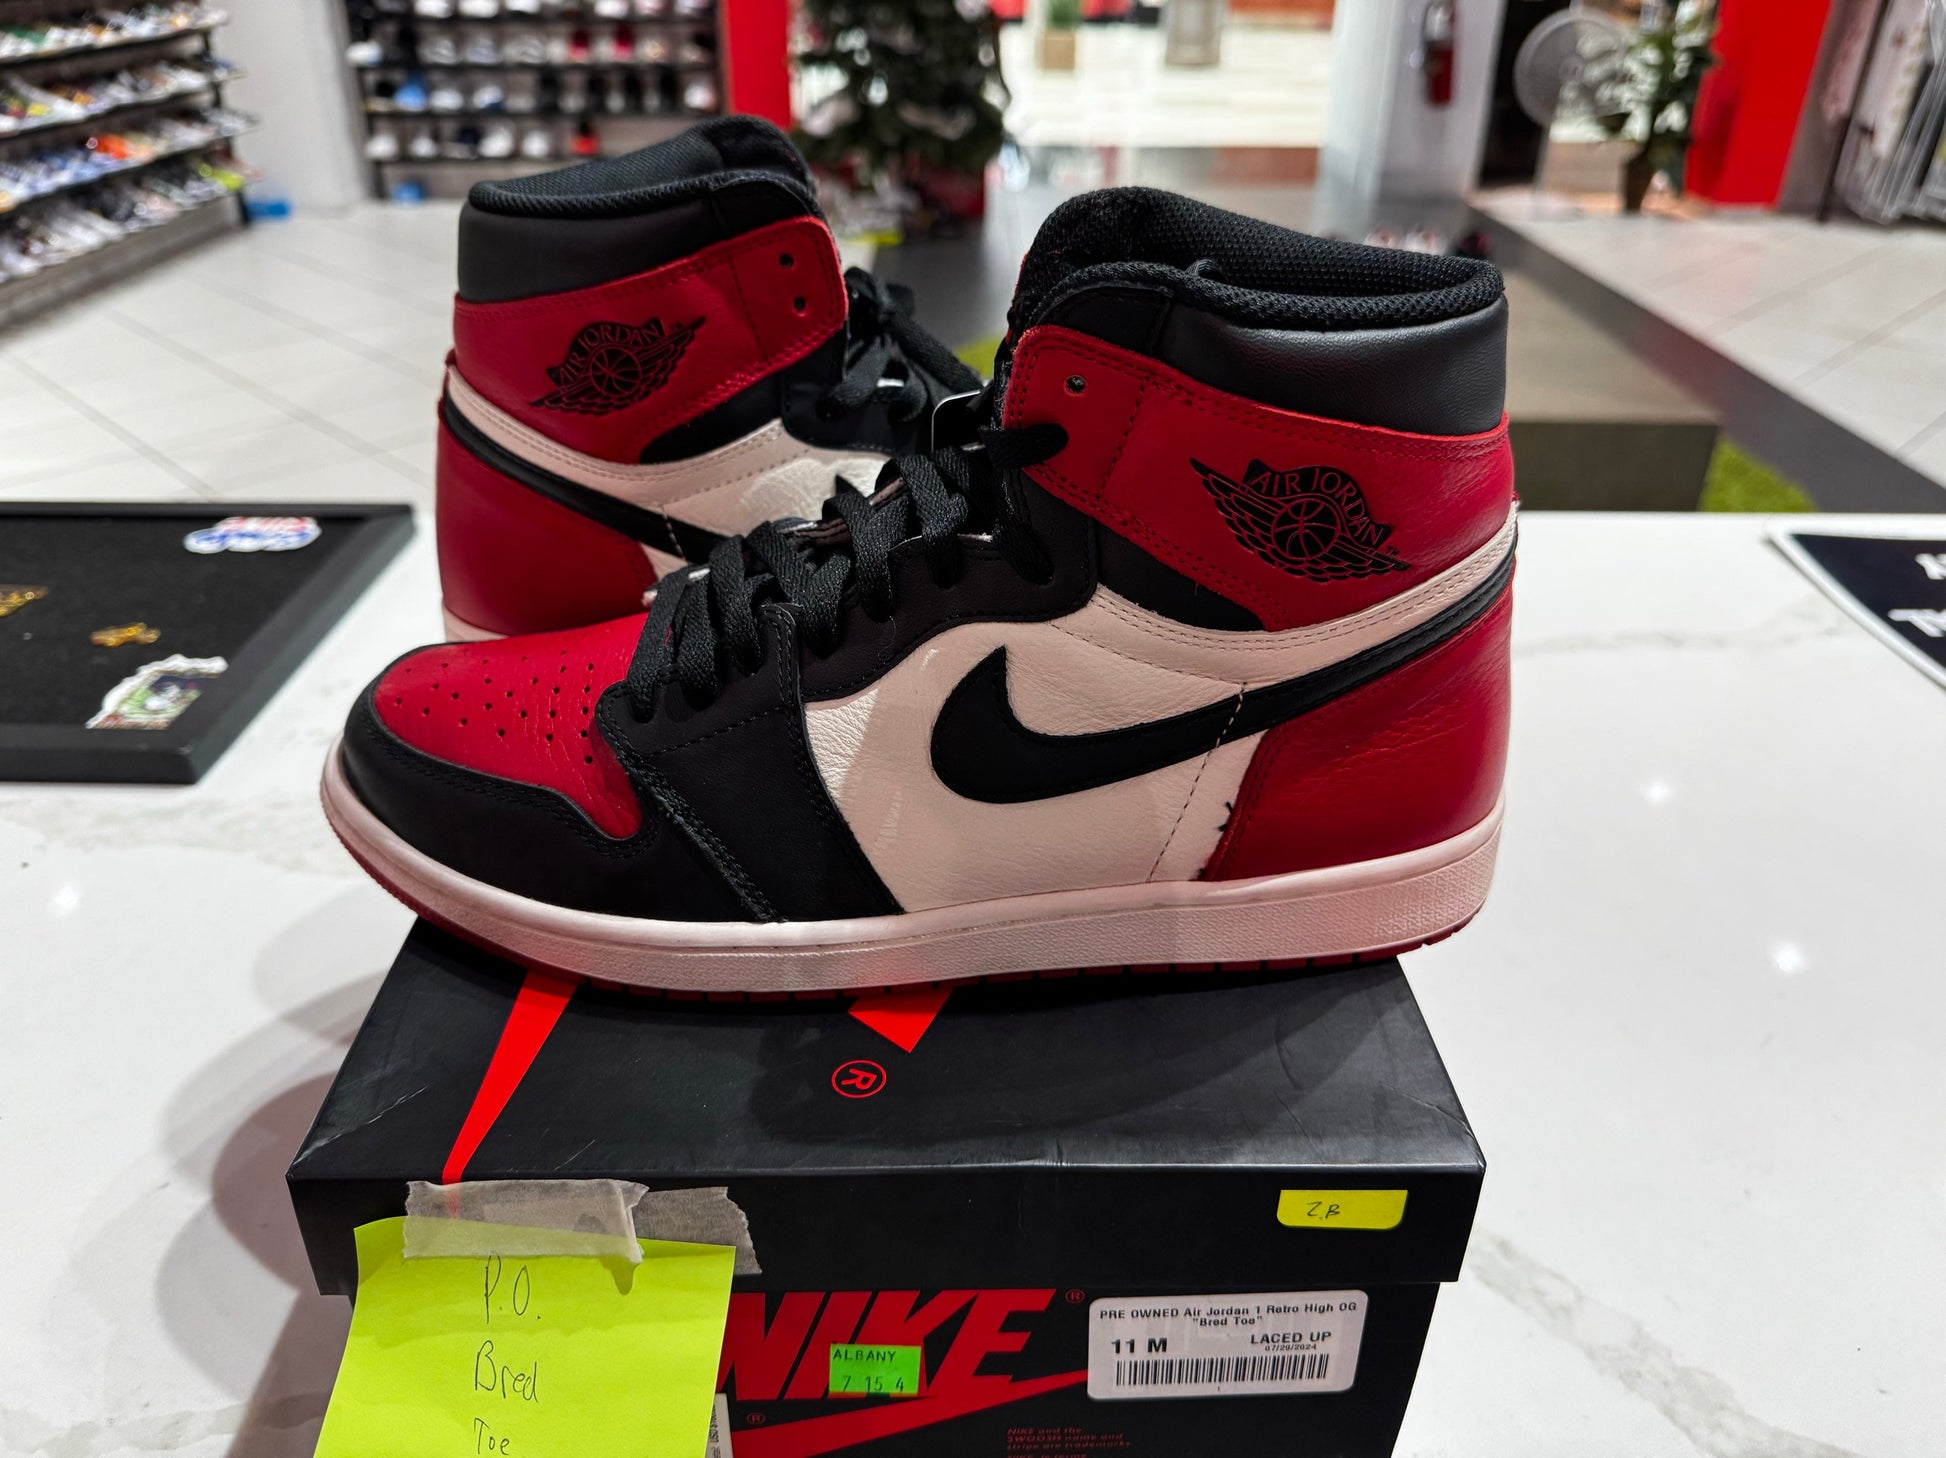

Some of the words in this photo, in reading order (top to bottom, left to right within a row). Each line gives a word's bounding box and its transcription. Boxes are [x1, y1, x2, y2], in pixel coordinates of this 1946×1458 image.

[559, 351, 586, 386] AIR
[578, 320, 666, 351] JORDAN
[1250, 471, 1302, 495] AIR
[1311, 468, 1384, 546] JORDAN
[484, 1254, 541, 1325] P.O.
[1100, 1309, 1126, 1319] PRE
[1131, 1308, 1179, 1319] OWNED
[1183, 1307, 1201, 1317] Air
[1206, 1305, 1249, 1316] Jordan
[1256, 1305, 1261, 1314] 1
[1266, 1304, 1299, 1314] Retro
[1304, 1302, 1334, 1314] High
[1339, 1301, 1357, 1312] OG
[1192, 1317, 1228, 1327] "Bred
[716, 1288, 1056, 1400] NIKE
[1111, 1338, 1135, 1354] 11
[1147, 1337, 1168, 1353] M
[1250, 1332, 1303, 1345] LACED
[1309, 1331, 1332, 1342] UP
[832, 1348, 896, 1362] ALBANY
[475, 1340, 539, 1403] Bred
[842, 1375, 852, 1392] 7
[865, 1375, 884, 1392] 15
[895, 1376, 904, 1392] 4
[473, 1416, 511, 1456] Toe
